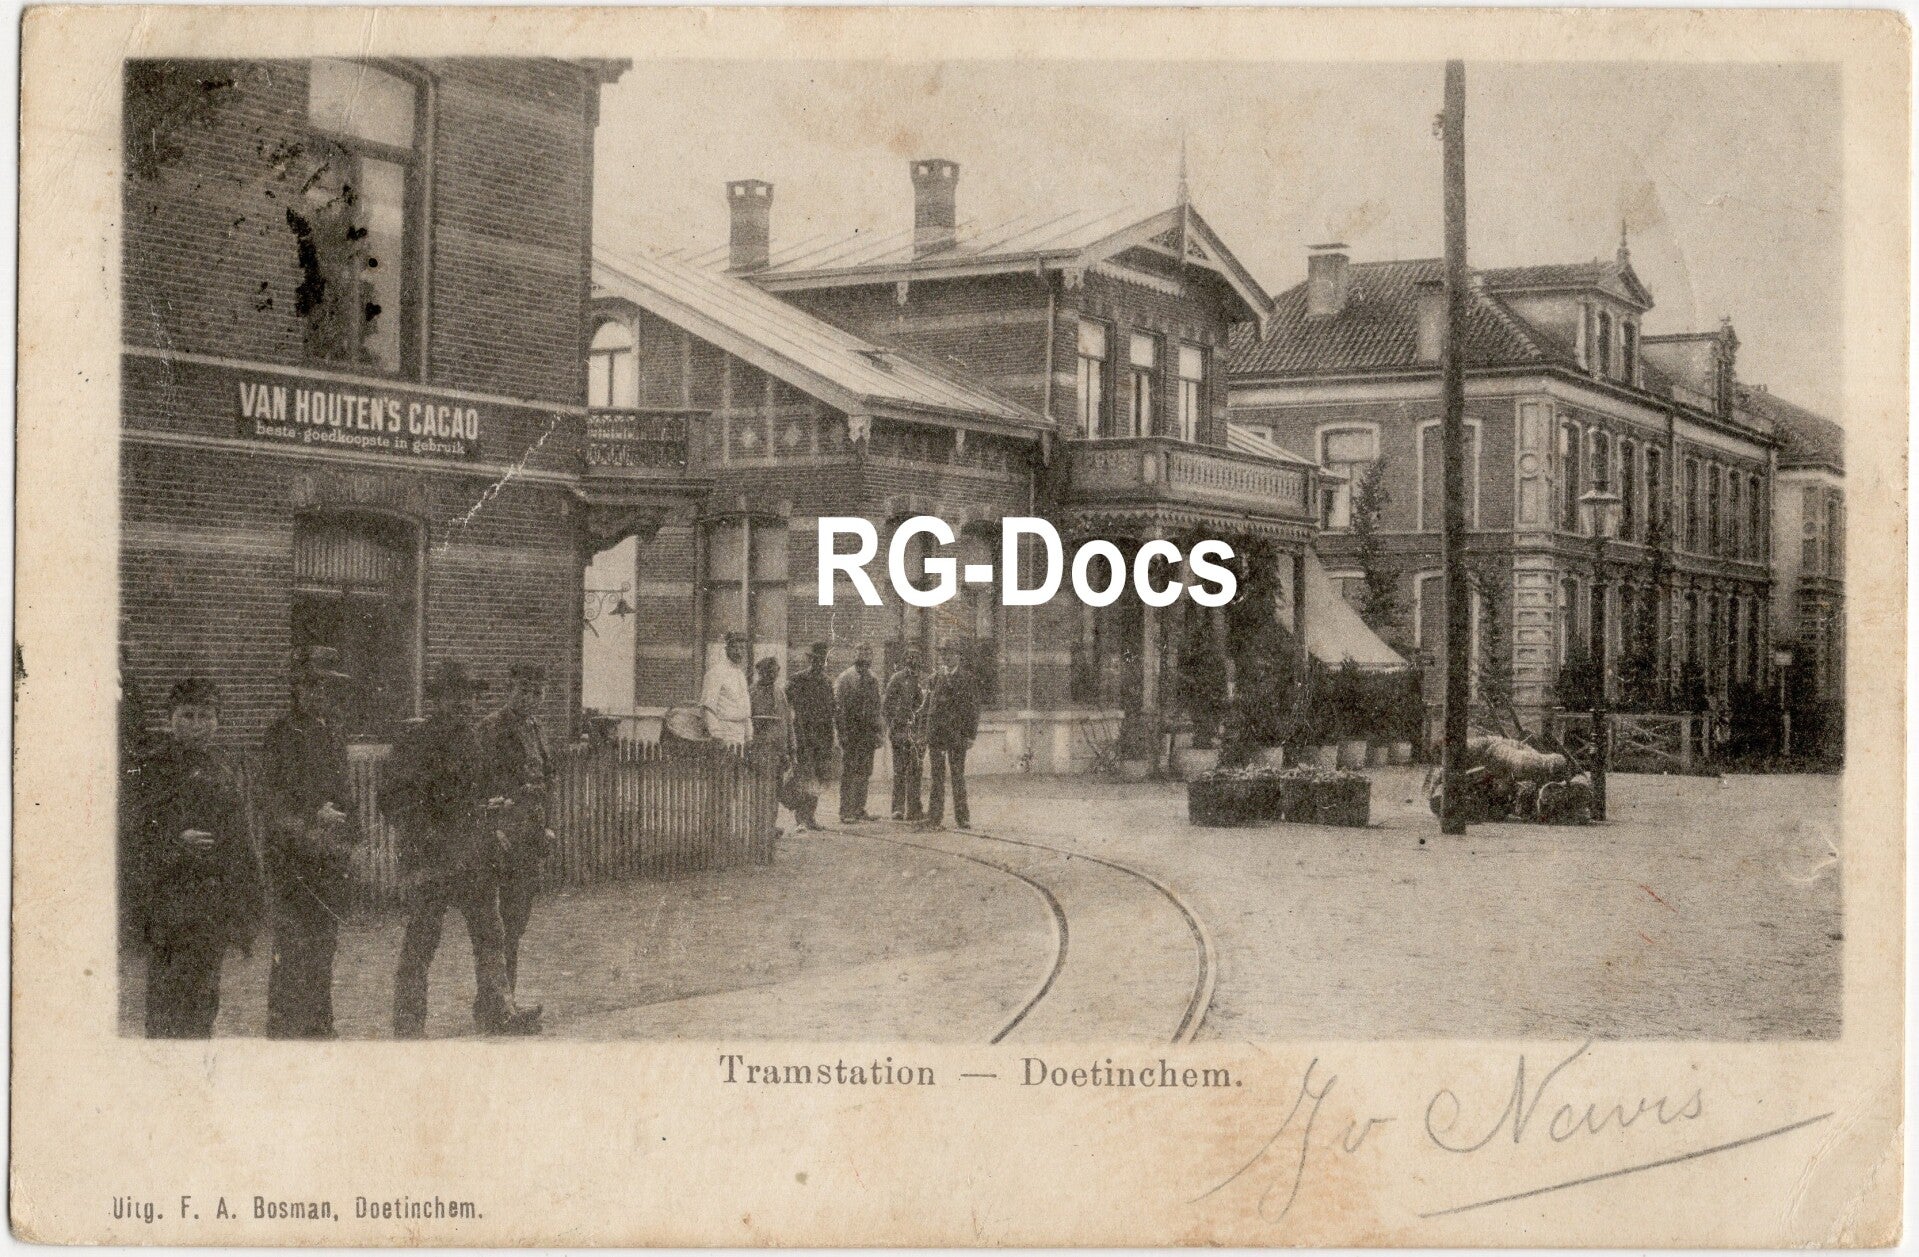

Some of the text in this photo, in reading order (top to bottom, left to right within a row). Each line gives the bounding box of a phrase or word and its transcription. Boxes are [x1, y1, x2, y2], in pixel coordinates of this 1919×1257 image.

[239, 381, 479, 441] VAN HOUTEN'S CACAO
[394, 436, 408, 450] in
[413, 438, 466, 455] gebruik
[719, 1054, 937, 1087] Tramstation
[1020, 1057, 1243, 1088] Doetinchem.
[180, 1195, 200, 1220] F.
[216, 1196, 237, 1220] A.
[253, 1196, 339, 1222] Bosman,
[355, 1196, 484, 1220] Doetinchem.
